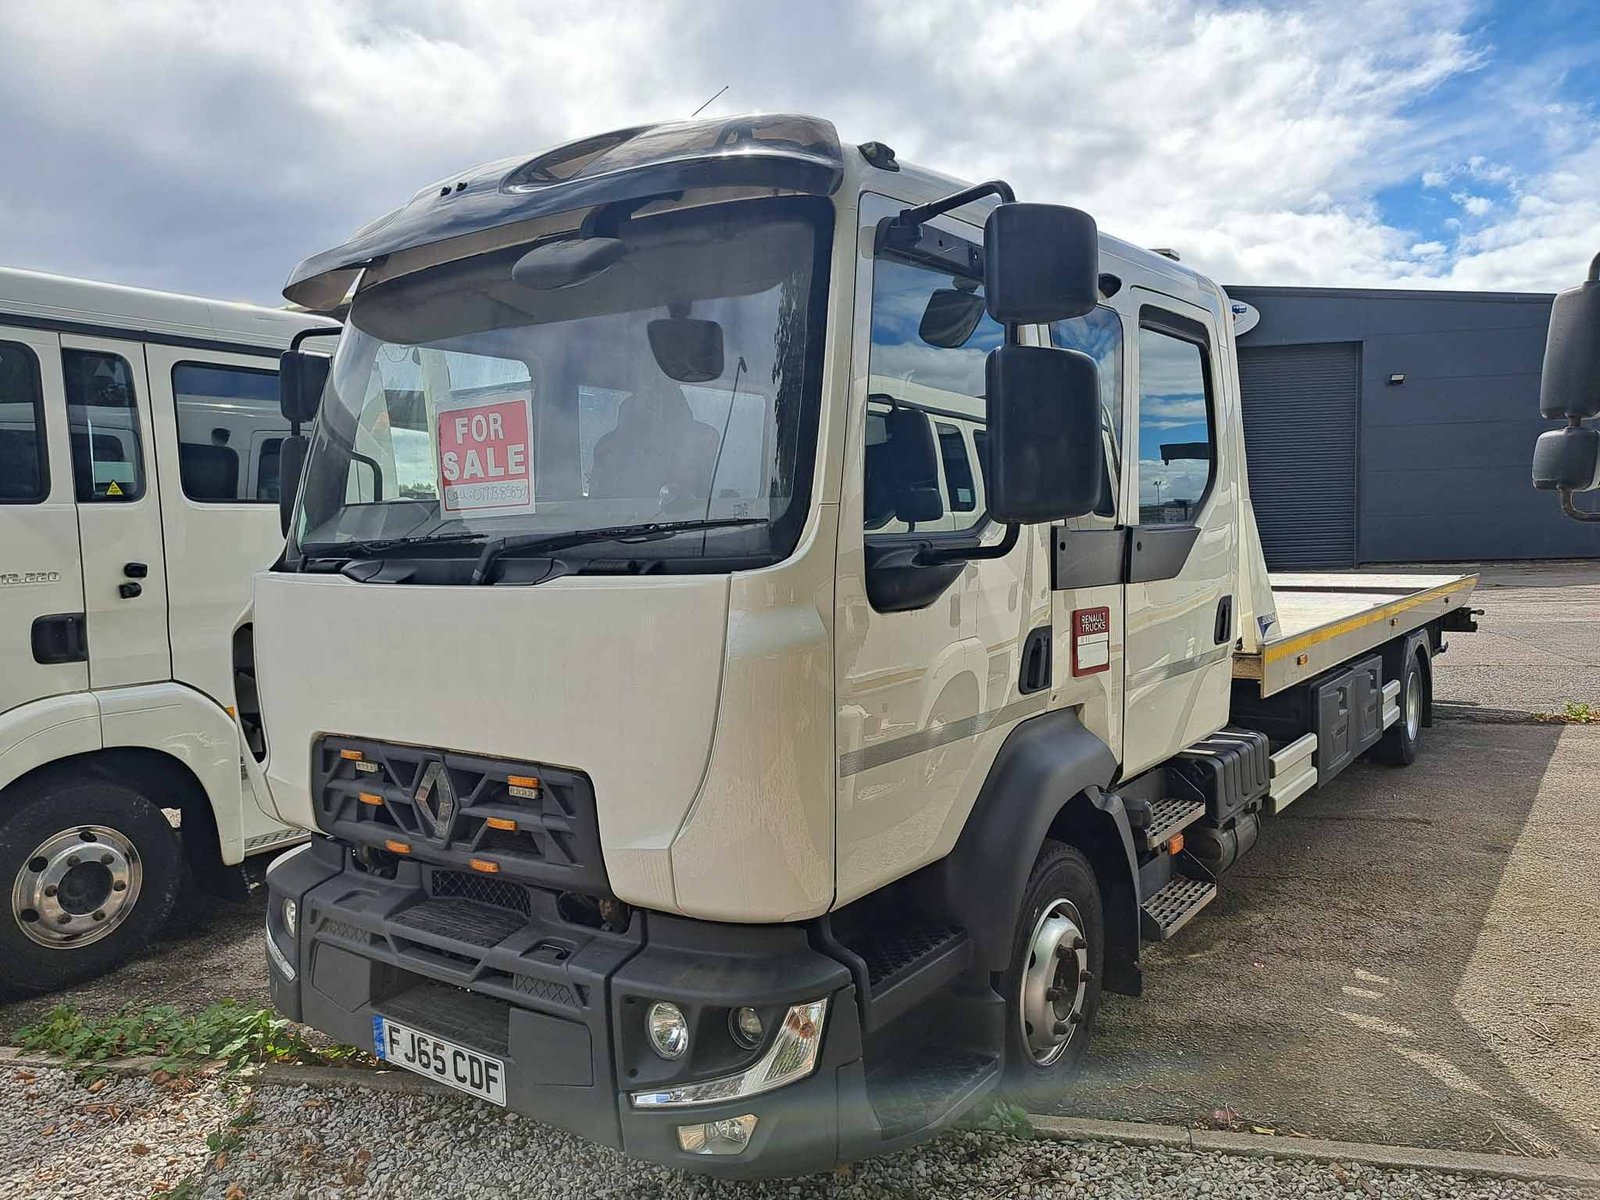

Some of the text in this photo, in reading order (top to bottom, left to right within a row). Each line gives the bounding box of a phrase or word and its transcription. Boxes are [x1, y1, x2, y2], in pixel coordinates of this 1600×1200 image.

[455, 412, 505, 445] FOR
[443, 444, 526, 481] SALE
[1081, 612, 1106, 625] RENAULT
[1081, 621, 1106, 633] TRUCKS
[388, 1025, 499, 1094] FJ65 CDF
